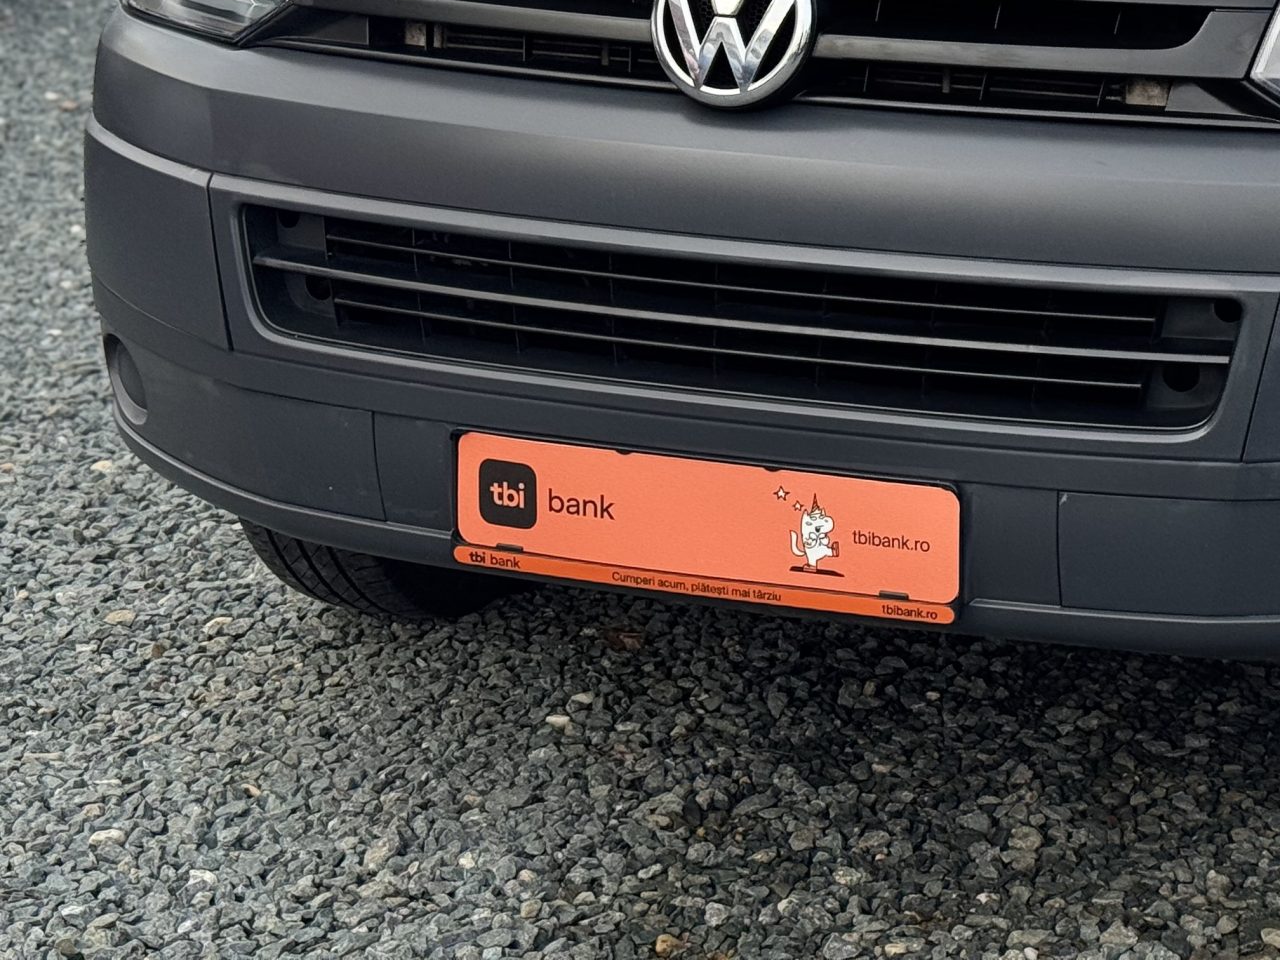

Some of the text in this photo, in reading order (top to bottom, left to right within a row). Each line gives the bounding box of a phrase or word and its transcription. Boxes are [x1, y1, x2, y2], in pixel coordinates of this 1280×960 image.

[490, 481, 616, 521] tbi bank
[852, 529, 931, 553] tbibank.ro
[468, 550, 521, 570] tbi bank
[611, 571, 656, 587] Cumperi
[657, 579, 689, 592] acum,
[731, 587, 751, 599] mai
[881, 603, 939, 621] tbibank.ro
